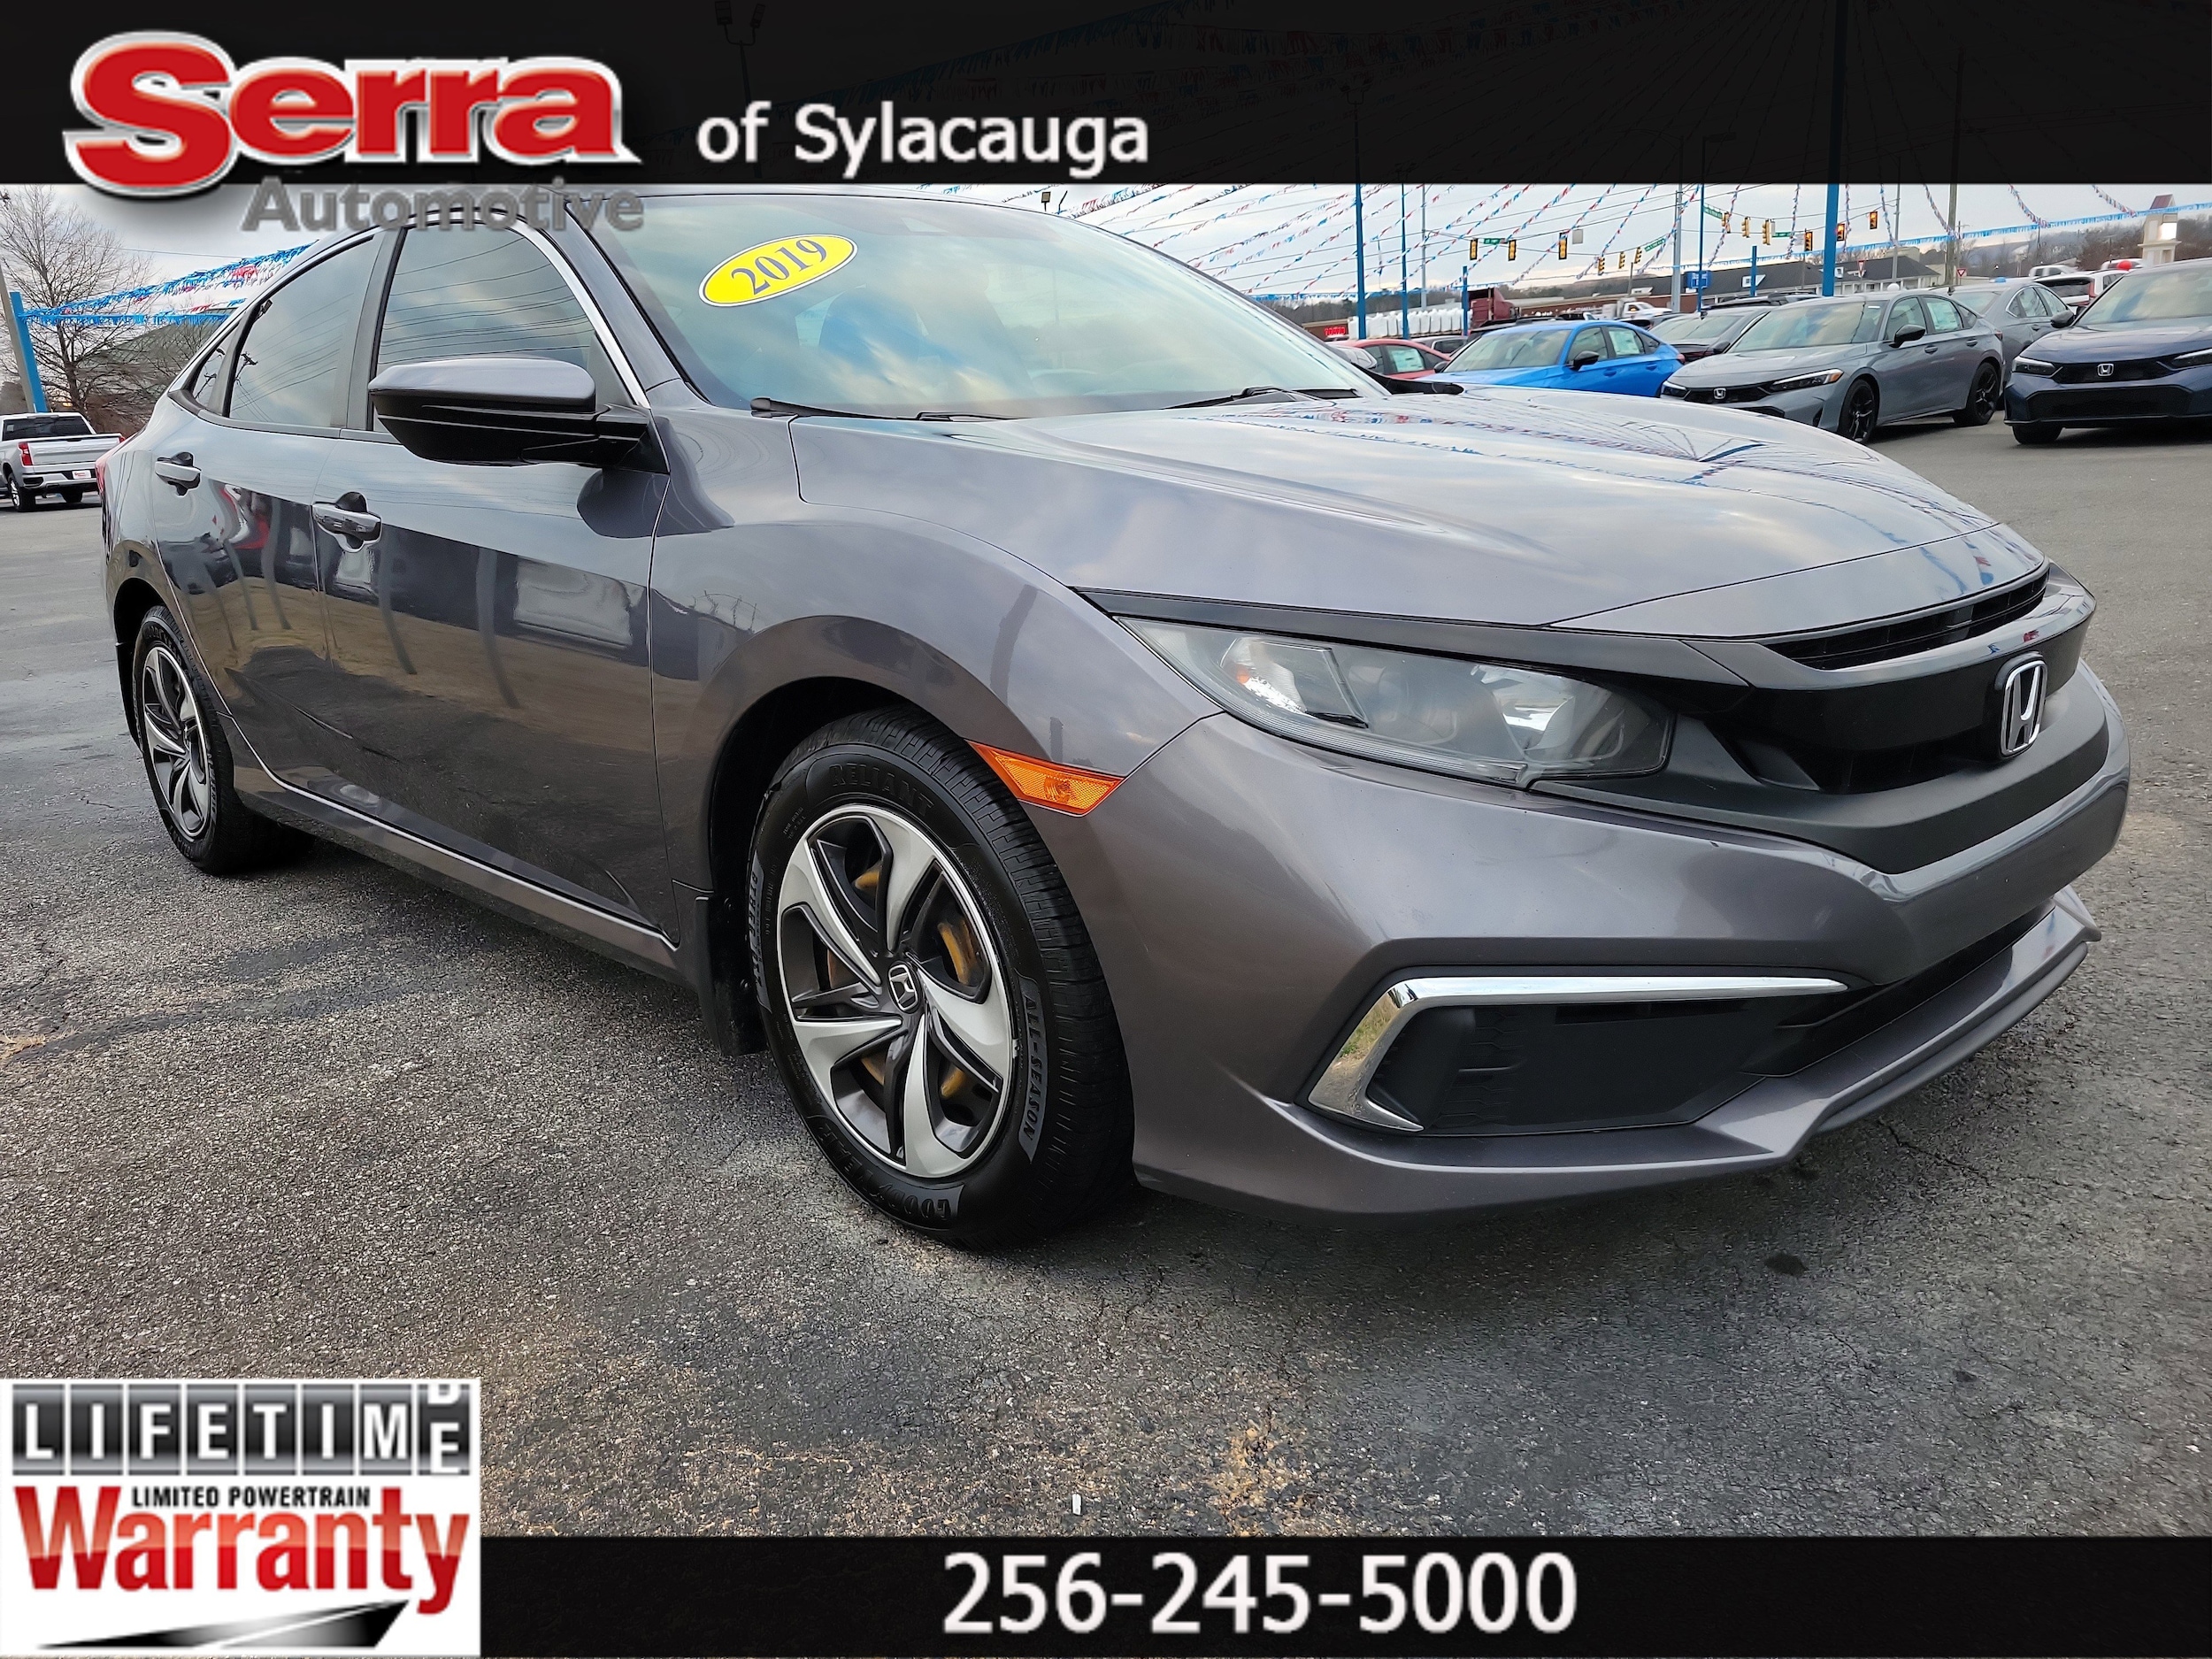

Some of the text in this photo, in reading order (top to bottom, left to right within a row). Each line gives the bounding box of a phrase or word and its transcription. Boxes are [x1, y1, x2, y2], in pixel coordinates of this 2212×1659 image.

[731, 238, 827, 296] 2019
[829, 762, 935, 817] RELIANT
[1023, 994, 1042, 1141] ALL-SEASON
